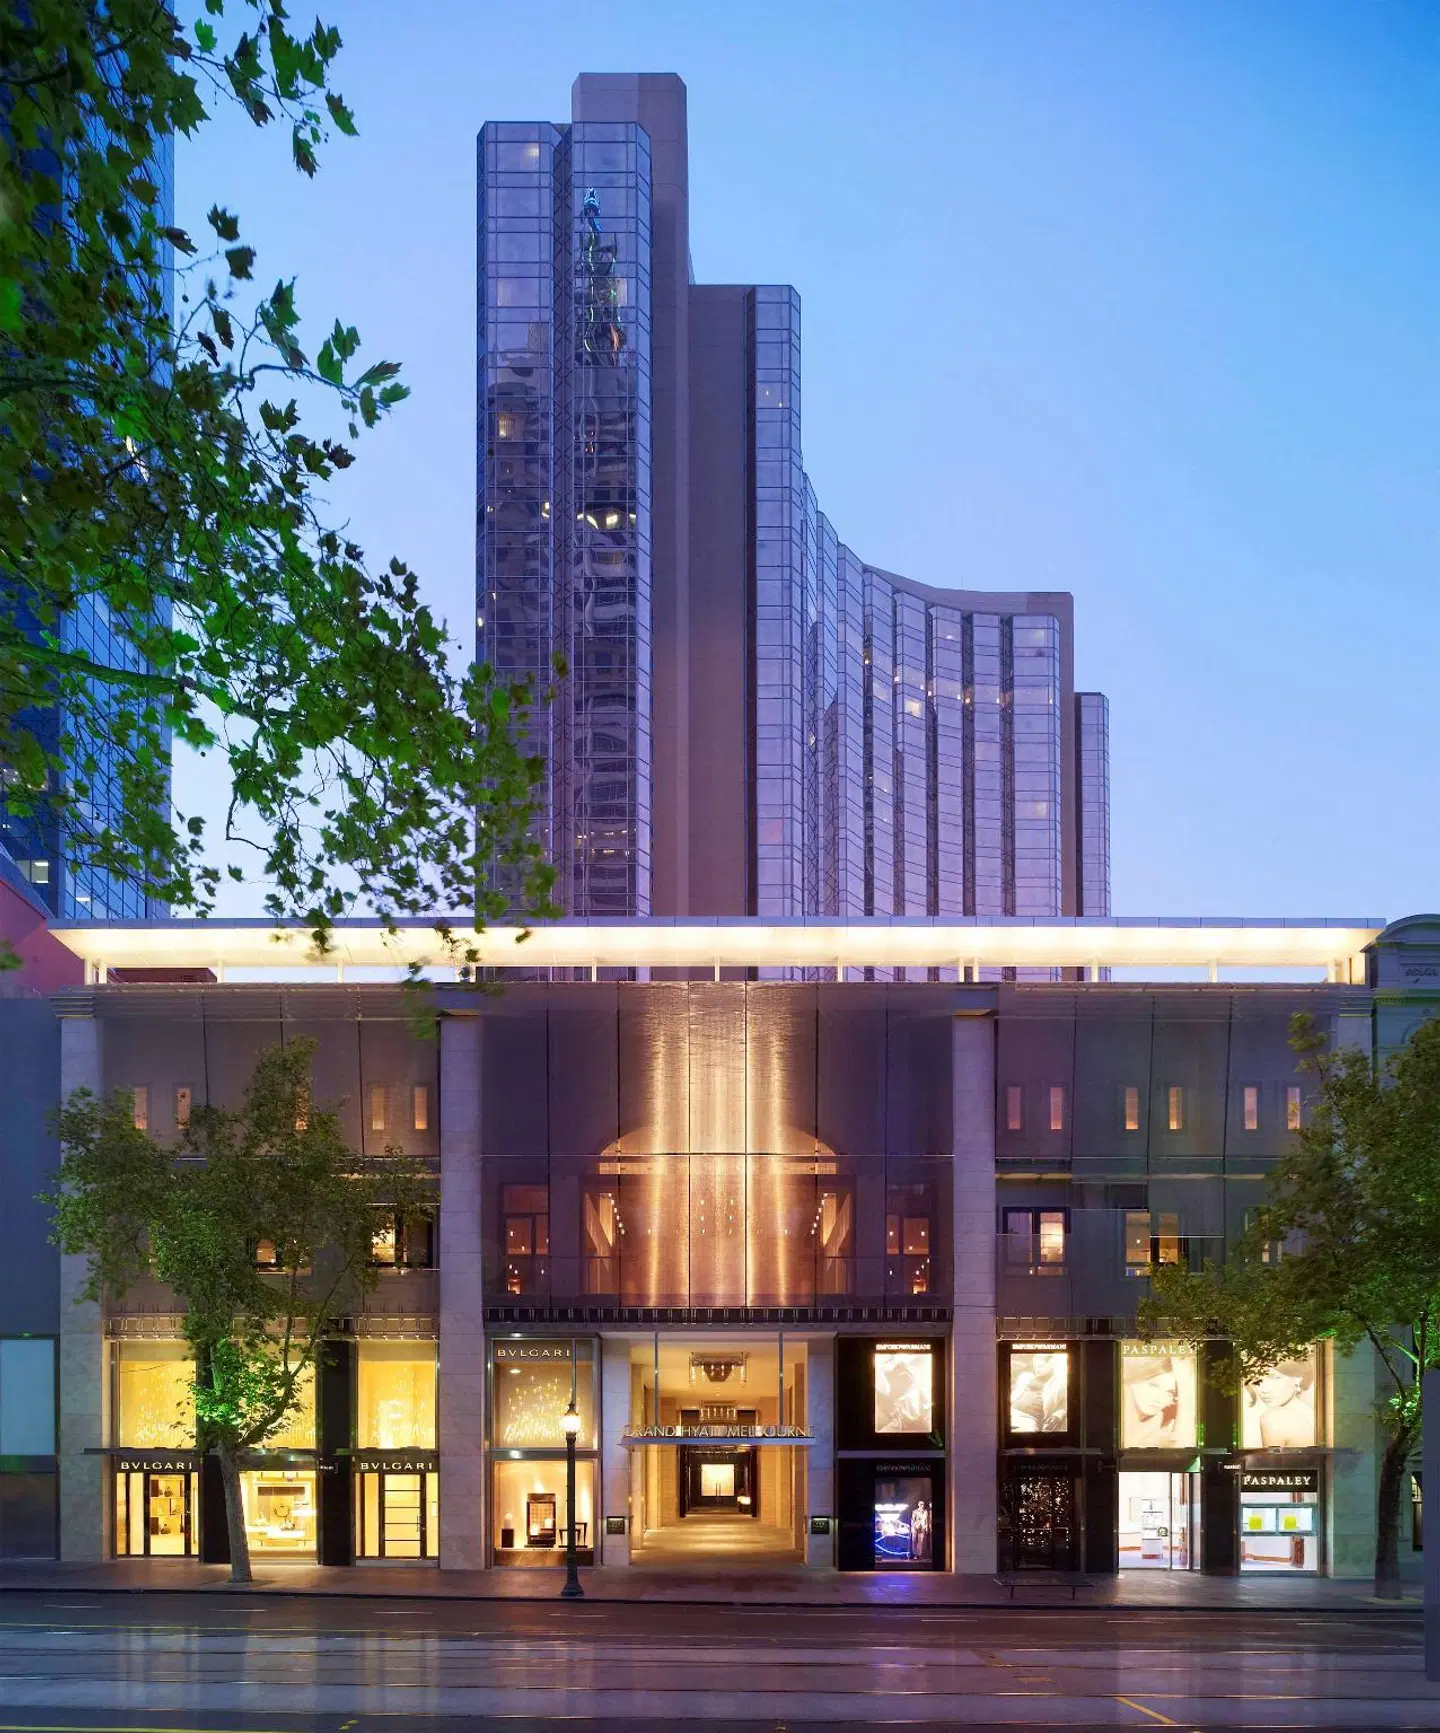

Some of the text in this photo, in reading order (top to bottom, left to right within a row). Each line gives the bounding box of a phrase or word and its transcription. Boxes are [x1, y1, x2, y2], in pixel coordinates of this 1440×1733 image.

[497, 1349, 570, 1357] BVLGARI
[120, 1462, 193, 1470] BVLGARI
[360, 1462, 433, 1470] BVLGARI
[1243, 1475, 1311, 1485] PASPALEY
